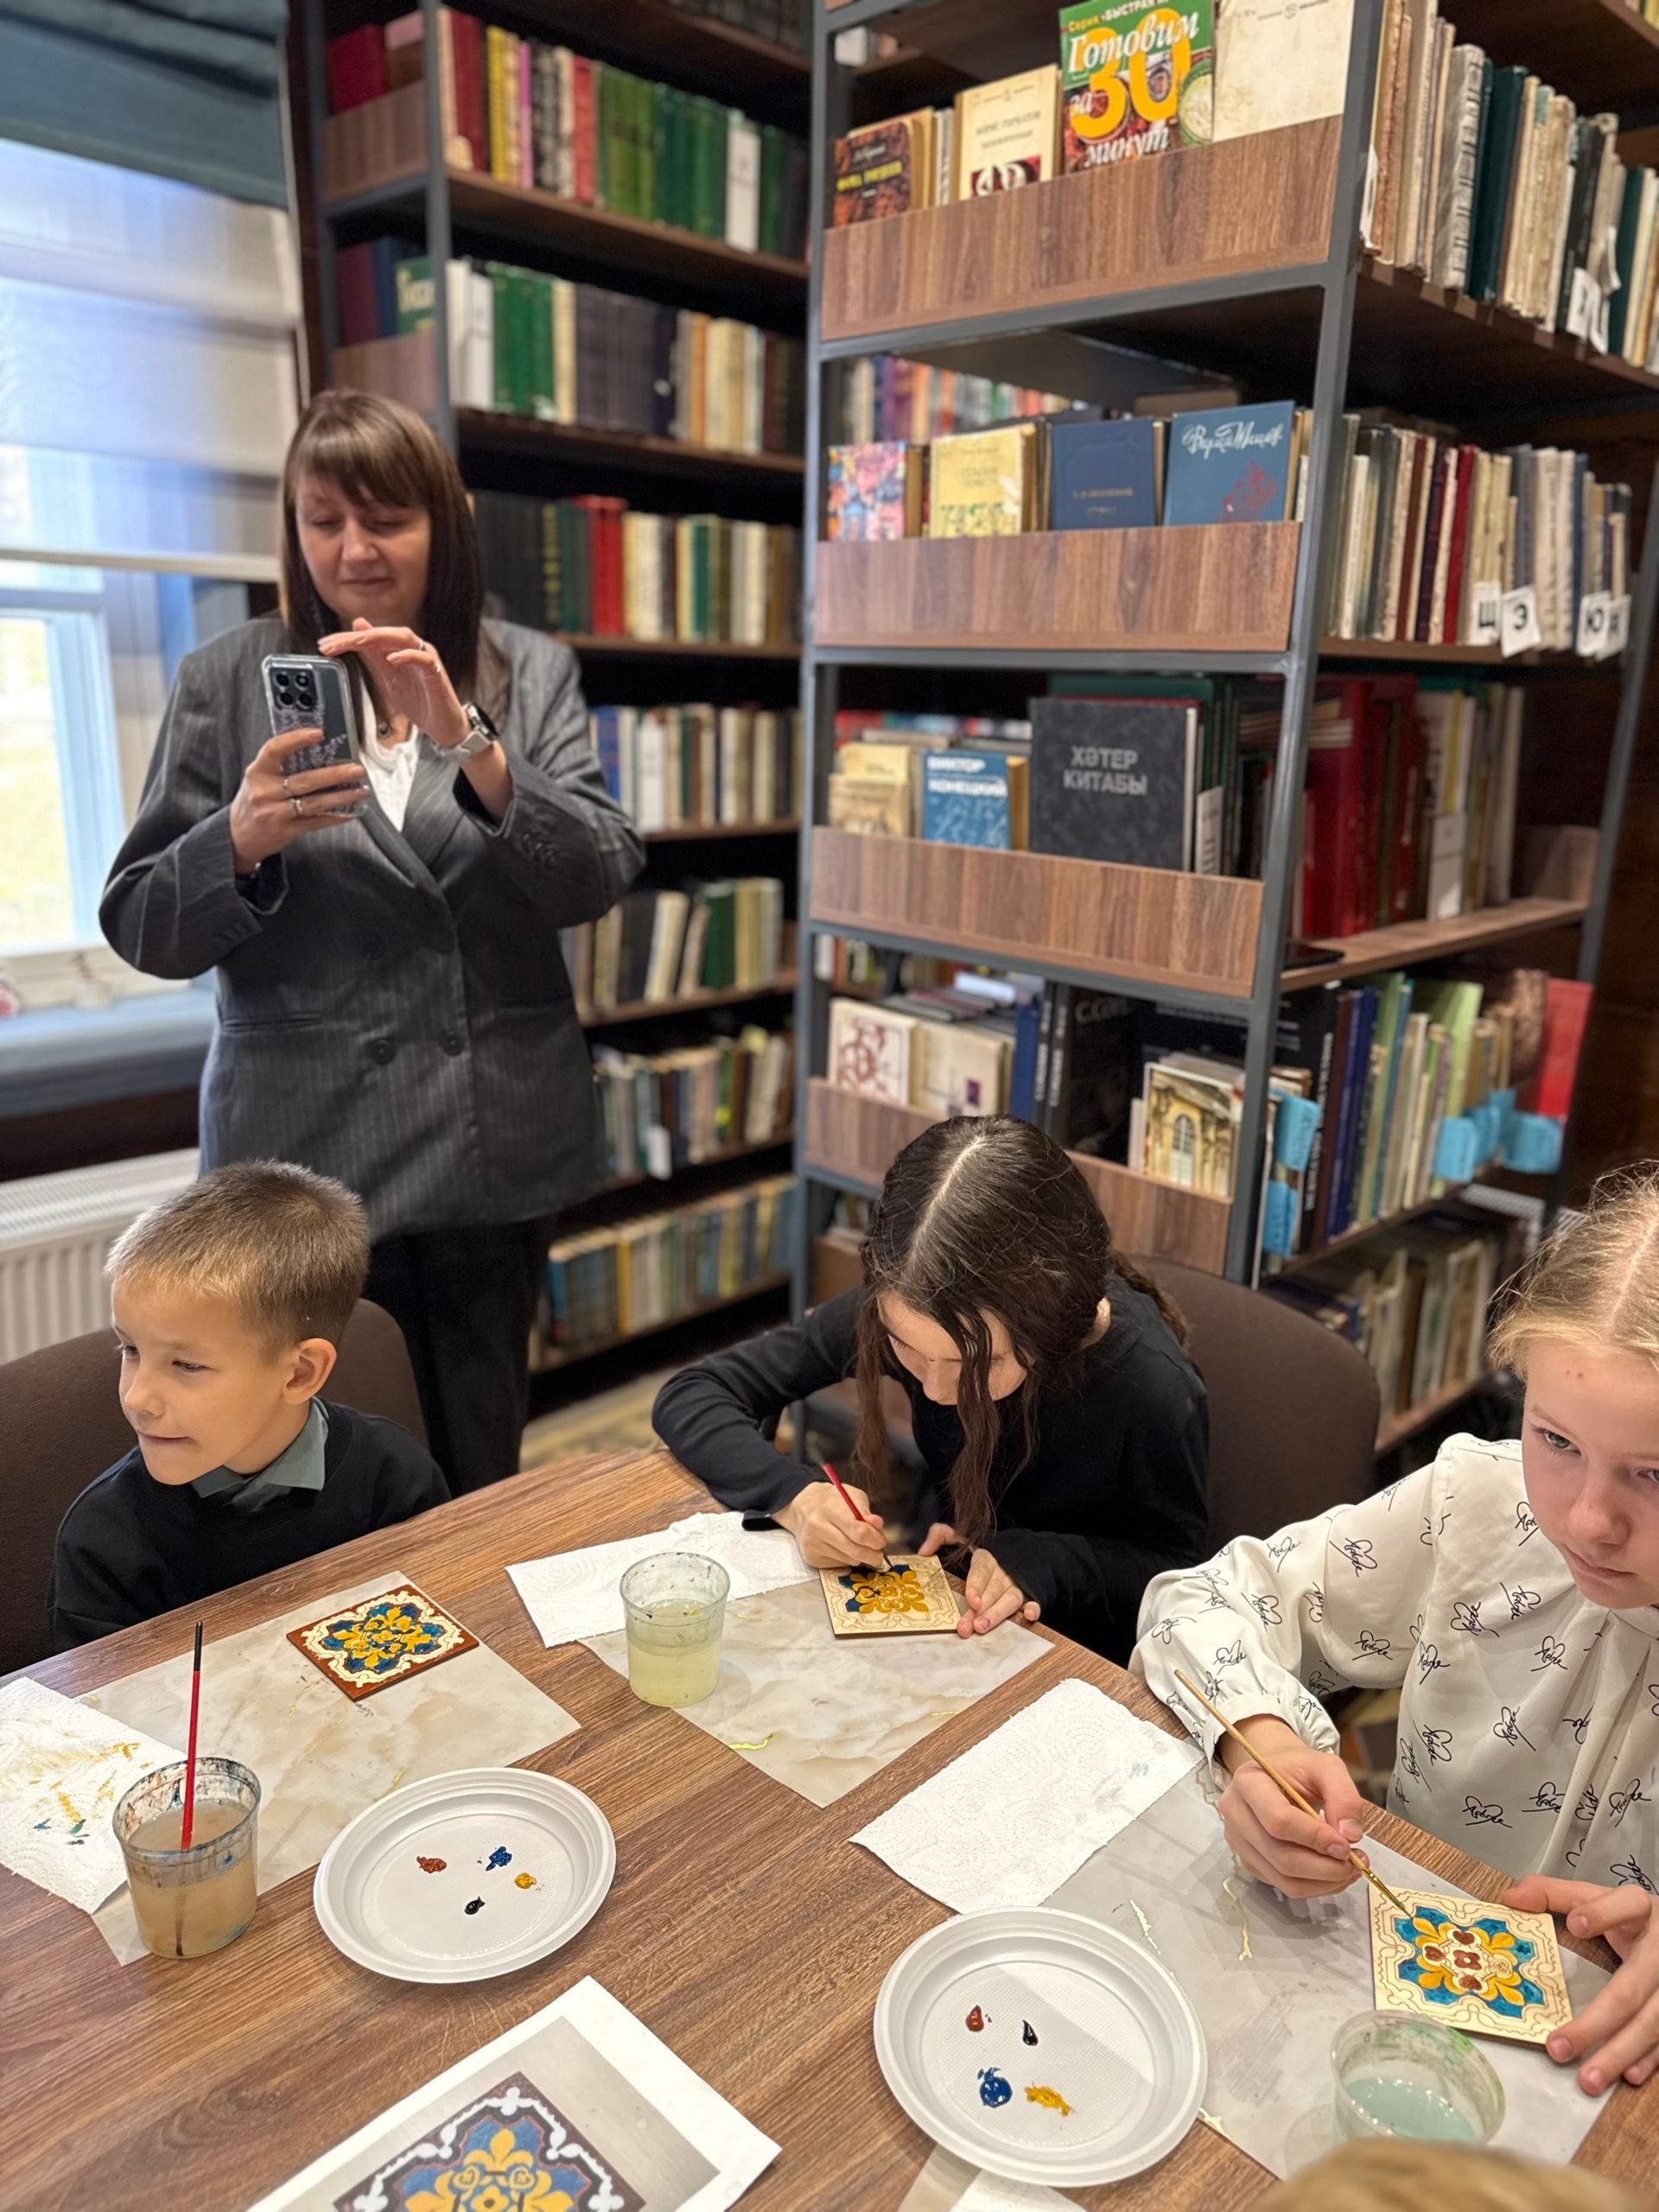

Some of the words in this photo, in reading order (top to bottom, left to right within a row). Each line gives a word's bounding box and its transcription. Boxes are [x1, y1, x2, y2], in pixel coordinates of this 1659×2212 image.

[1068, 11, 1199, 73] Готовим
[1070, 8, 1191, 138] 30
[1084, 124, 1170, 168] минут
[1071, 746, 1138, 771] ХӘТЕР
[1064, 770, 1147, 795] КИТАБЫ
